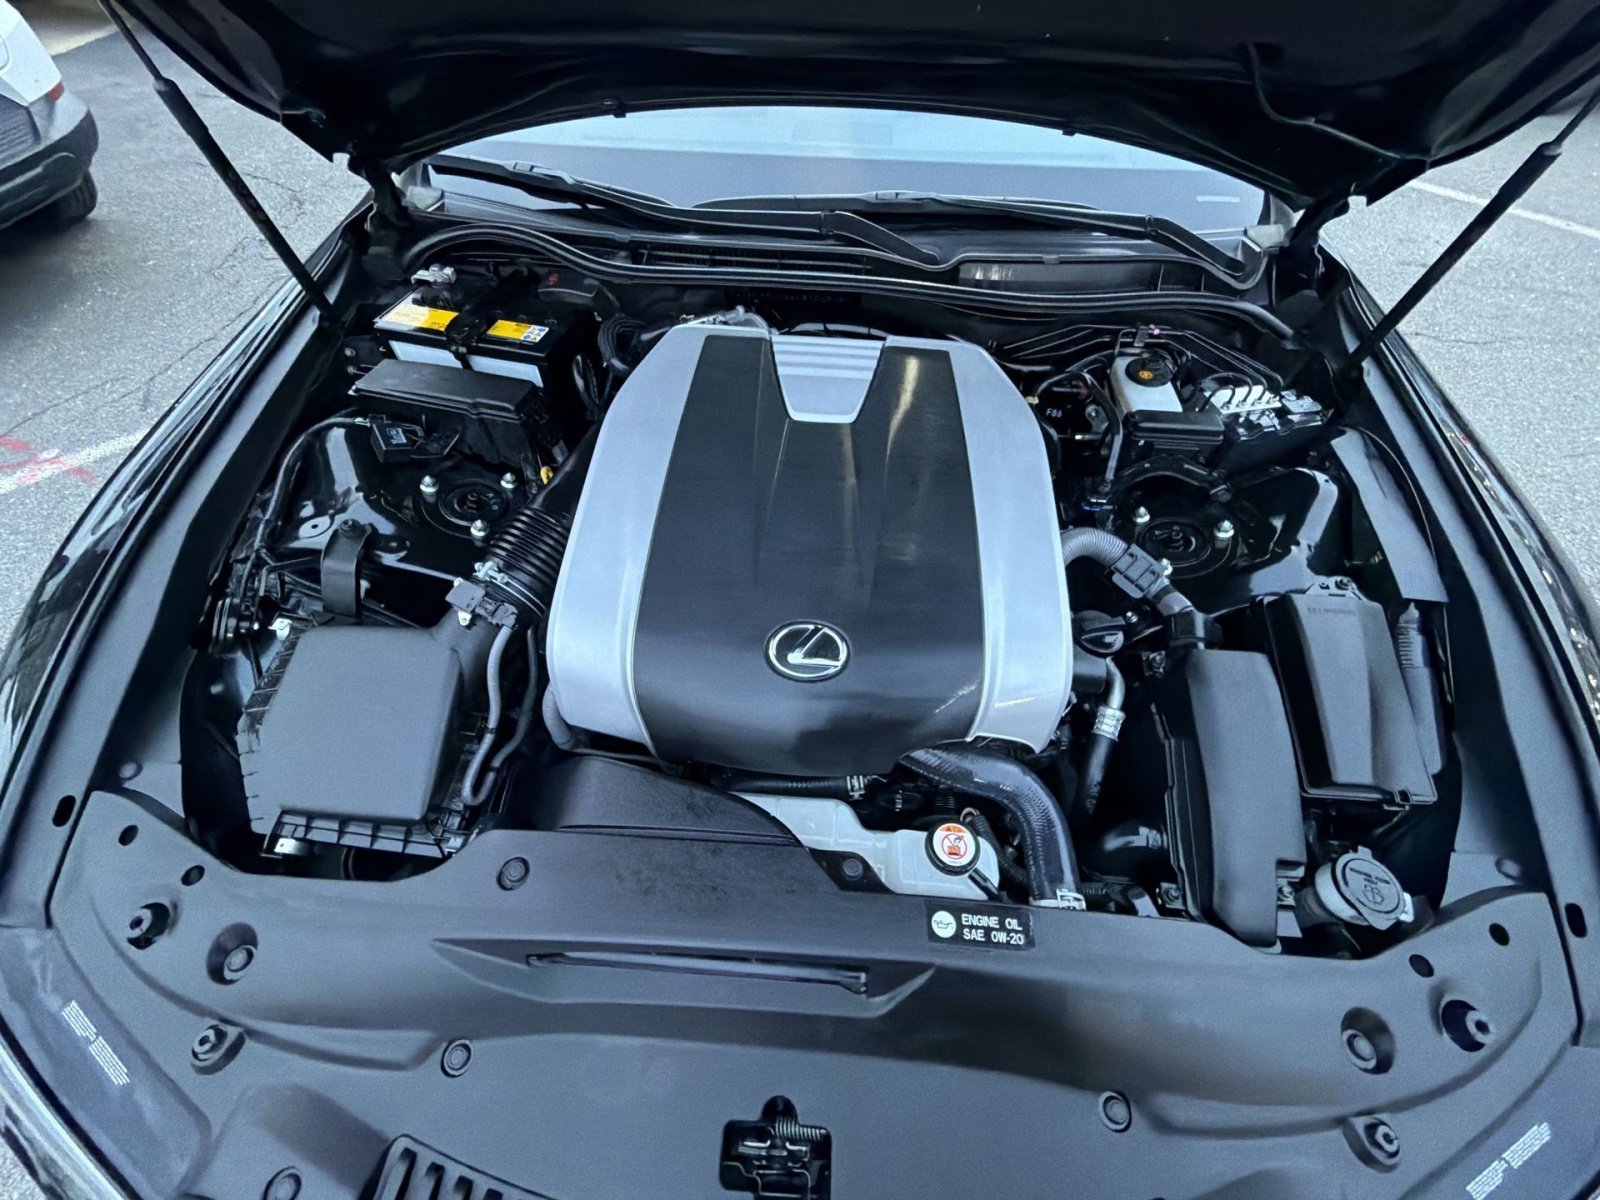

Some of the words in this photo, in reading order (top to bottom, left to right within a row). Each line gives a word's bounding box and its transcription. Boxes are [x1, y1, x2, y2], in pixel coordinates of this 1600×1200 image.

[961, 913, 1000, 929] ENGINE
[1005, 917, 1023, 931] OIL
[963, 928, 986, 942] SAE
[990, 930, 1025, 945] 0W-20
